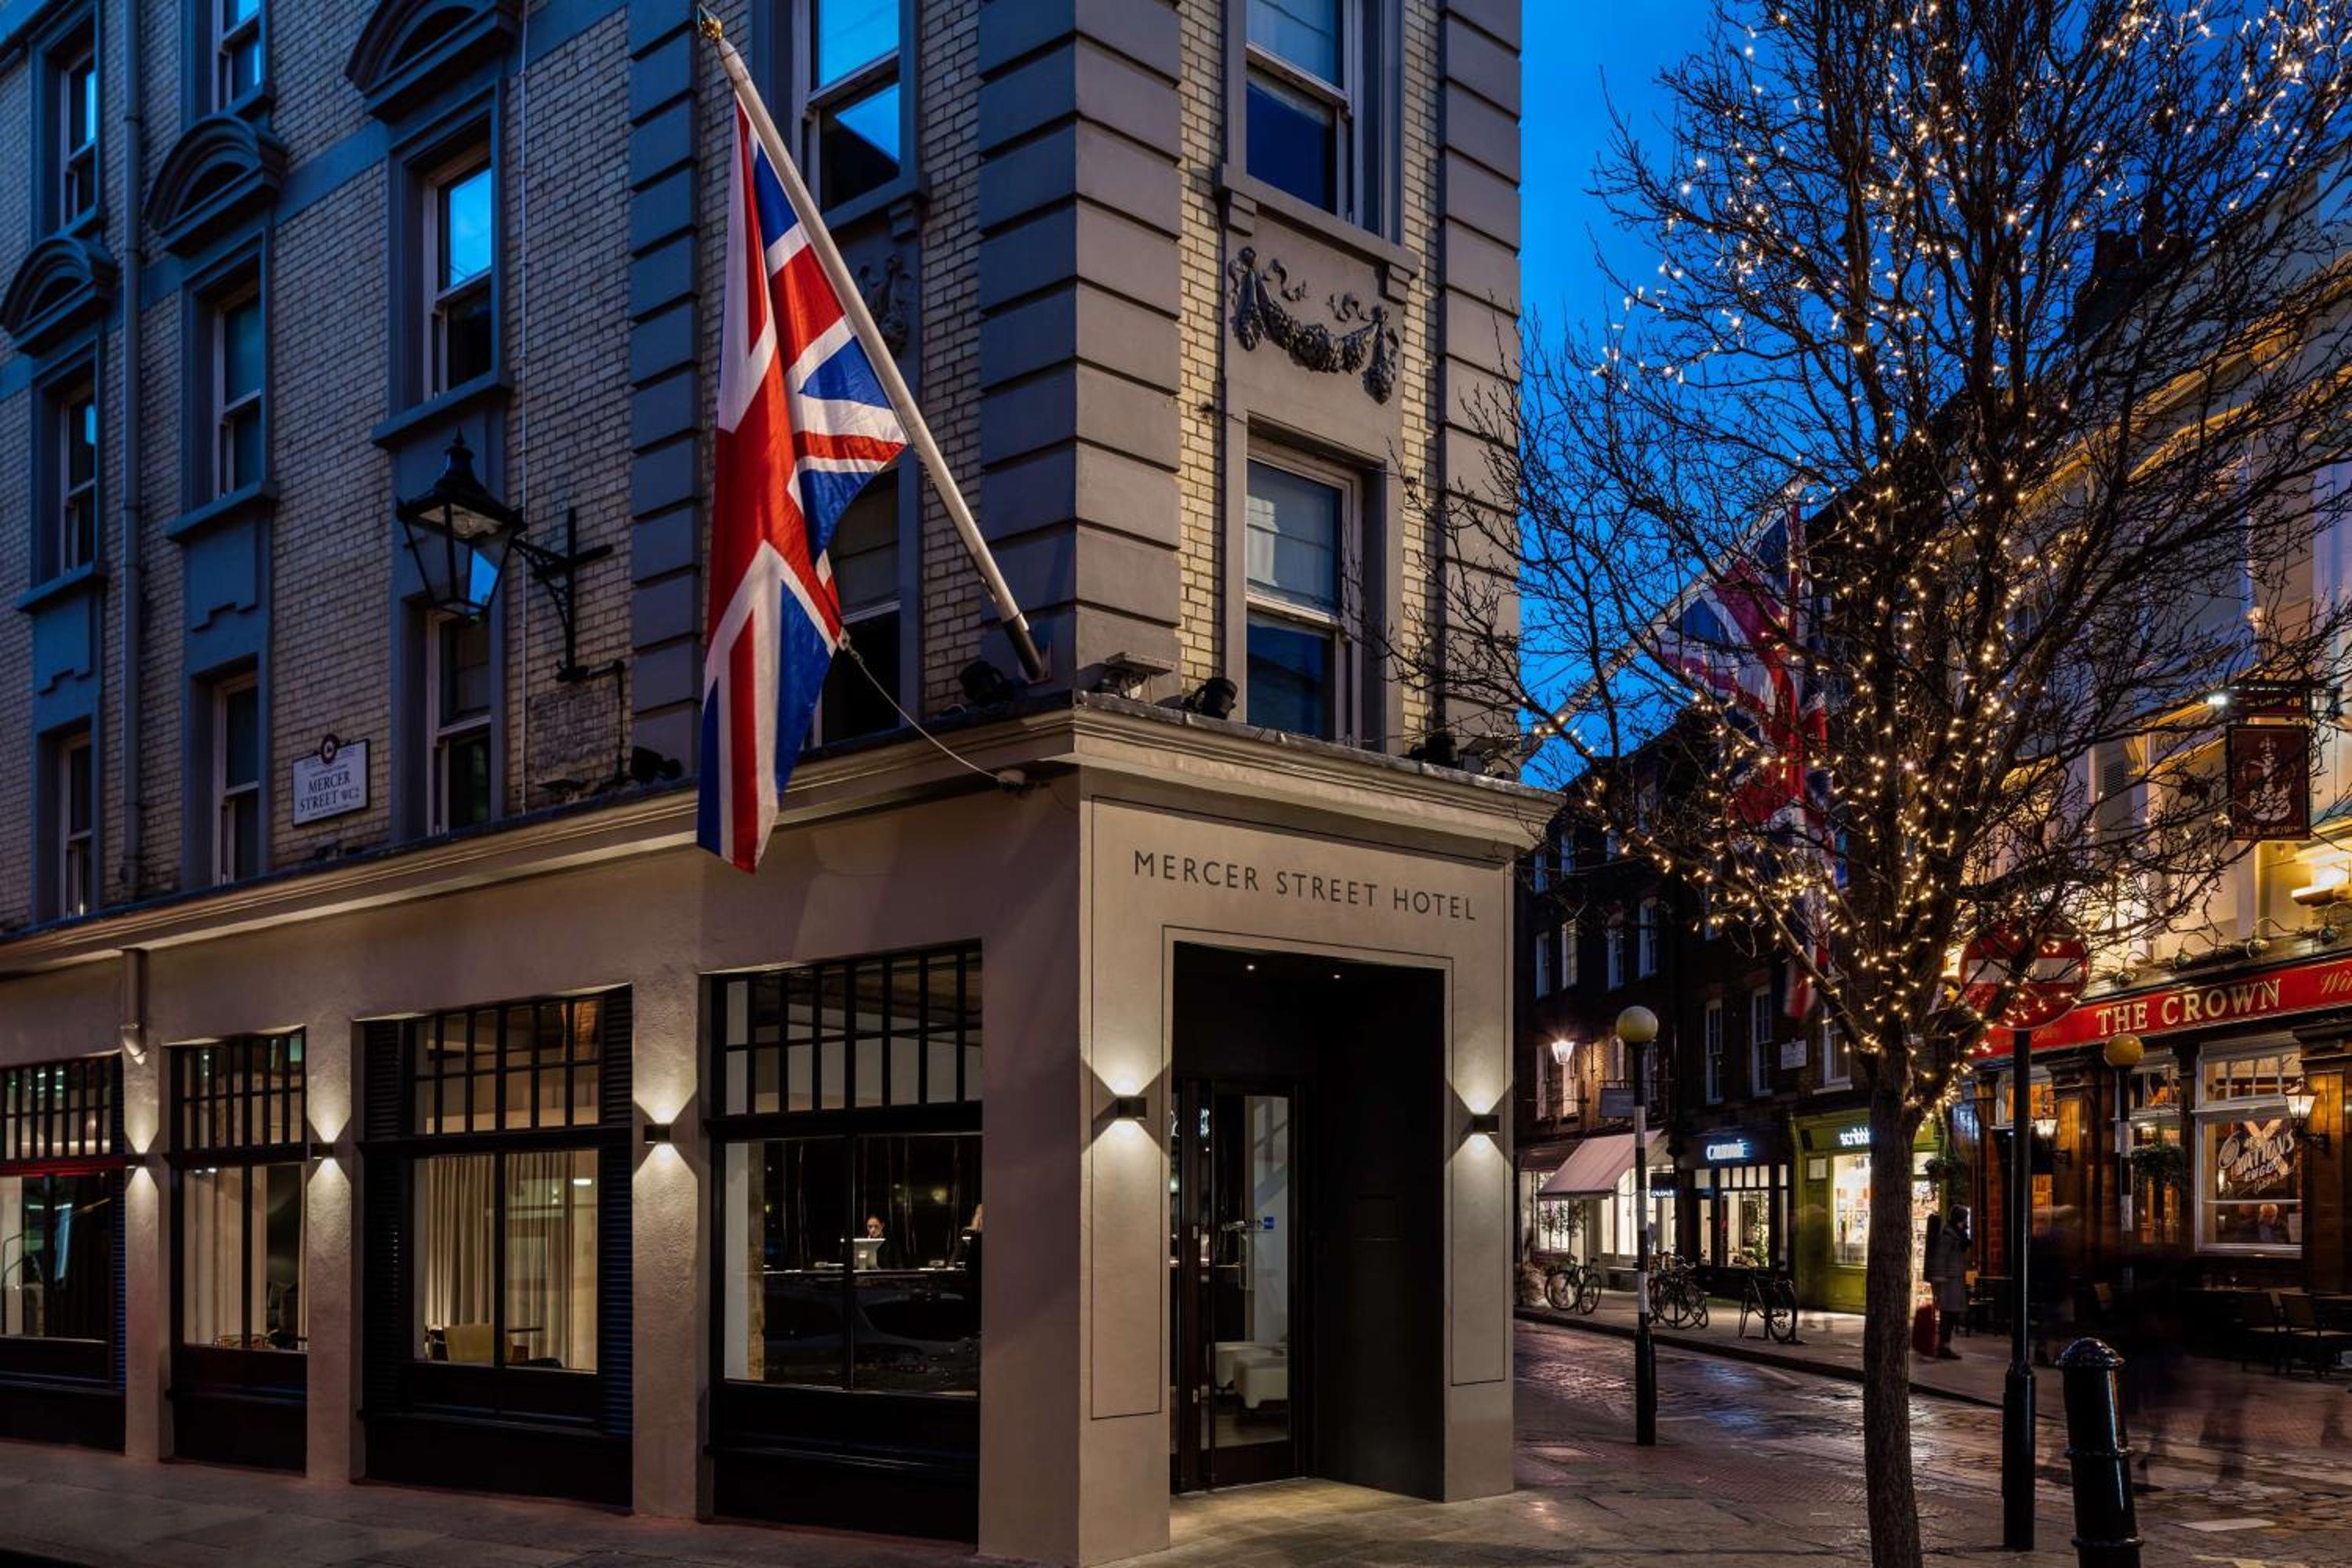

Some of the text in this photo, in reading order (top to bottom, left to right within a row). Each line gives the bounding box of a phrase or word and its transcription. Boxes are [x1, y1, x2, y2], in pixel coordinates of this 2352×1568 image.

[300, 790, 338, 813] STREET
[308, 770, 350, 794] MERCER
[1134, 851, 1476, 920] MERCER STREET HOTEL
[2096, 1001, 2147, 1036] THE
[2161, 978, 2281, 1025] CROWN
